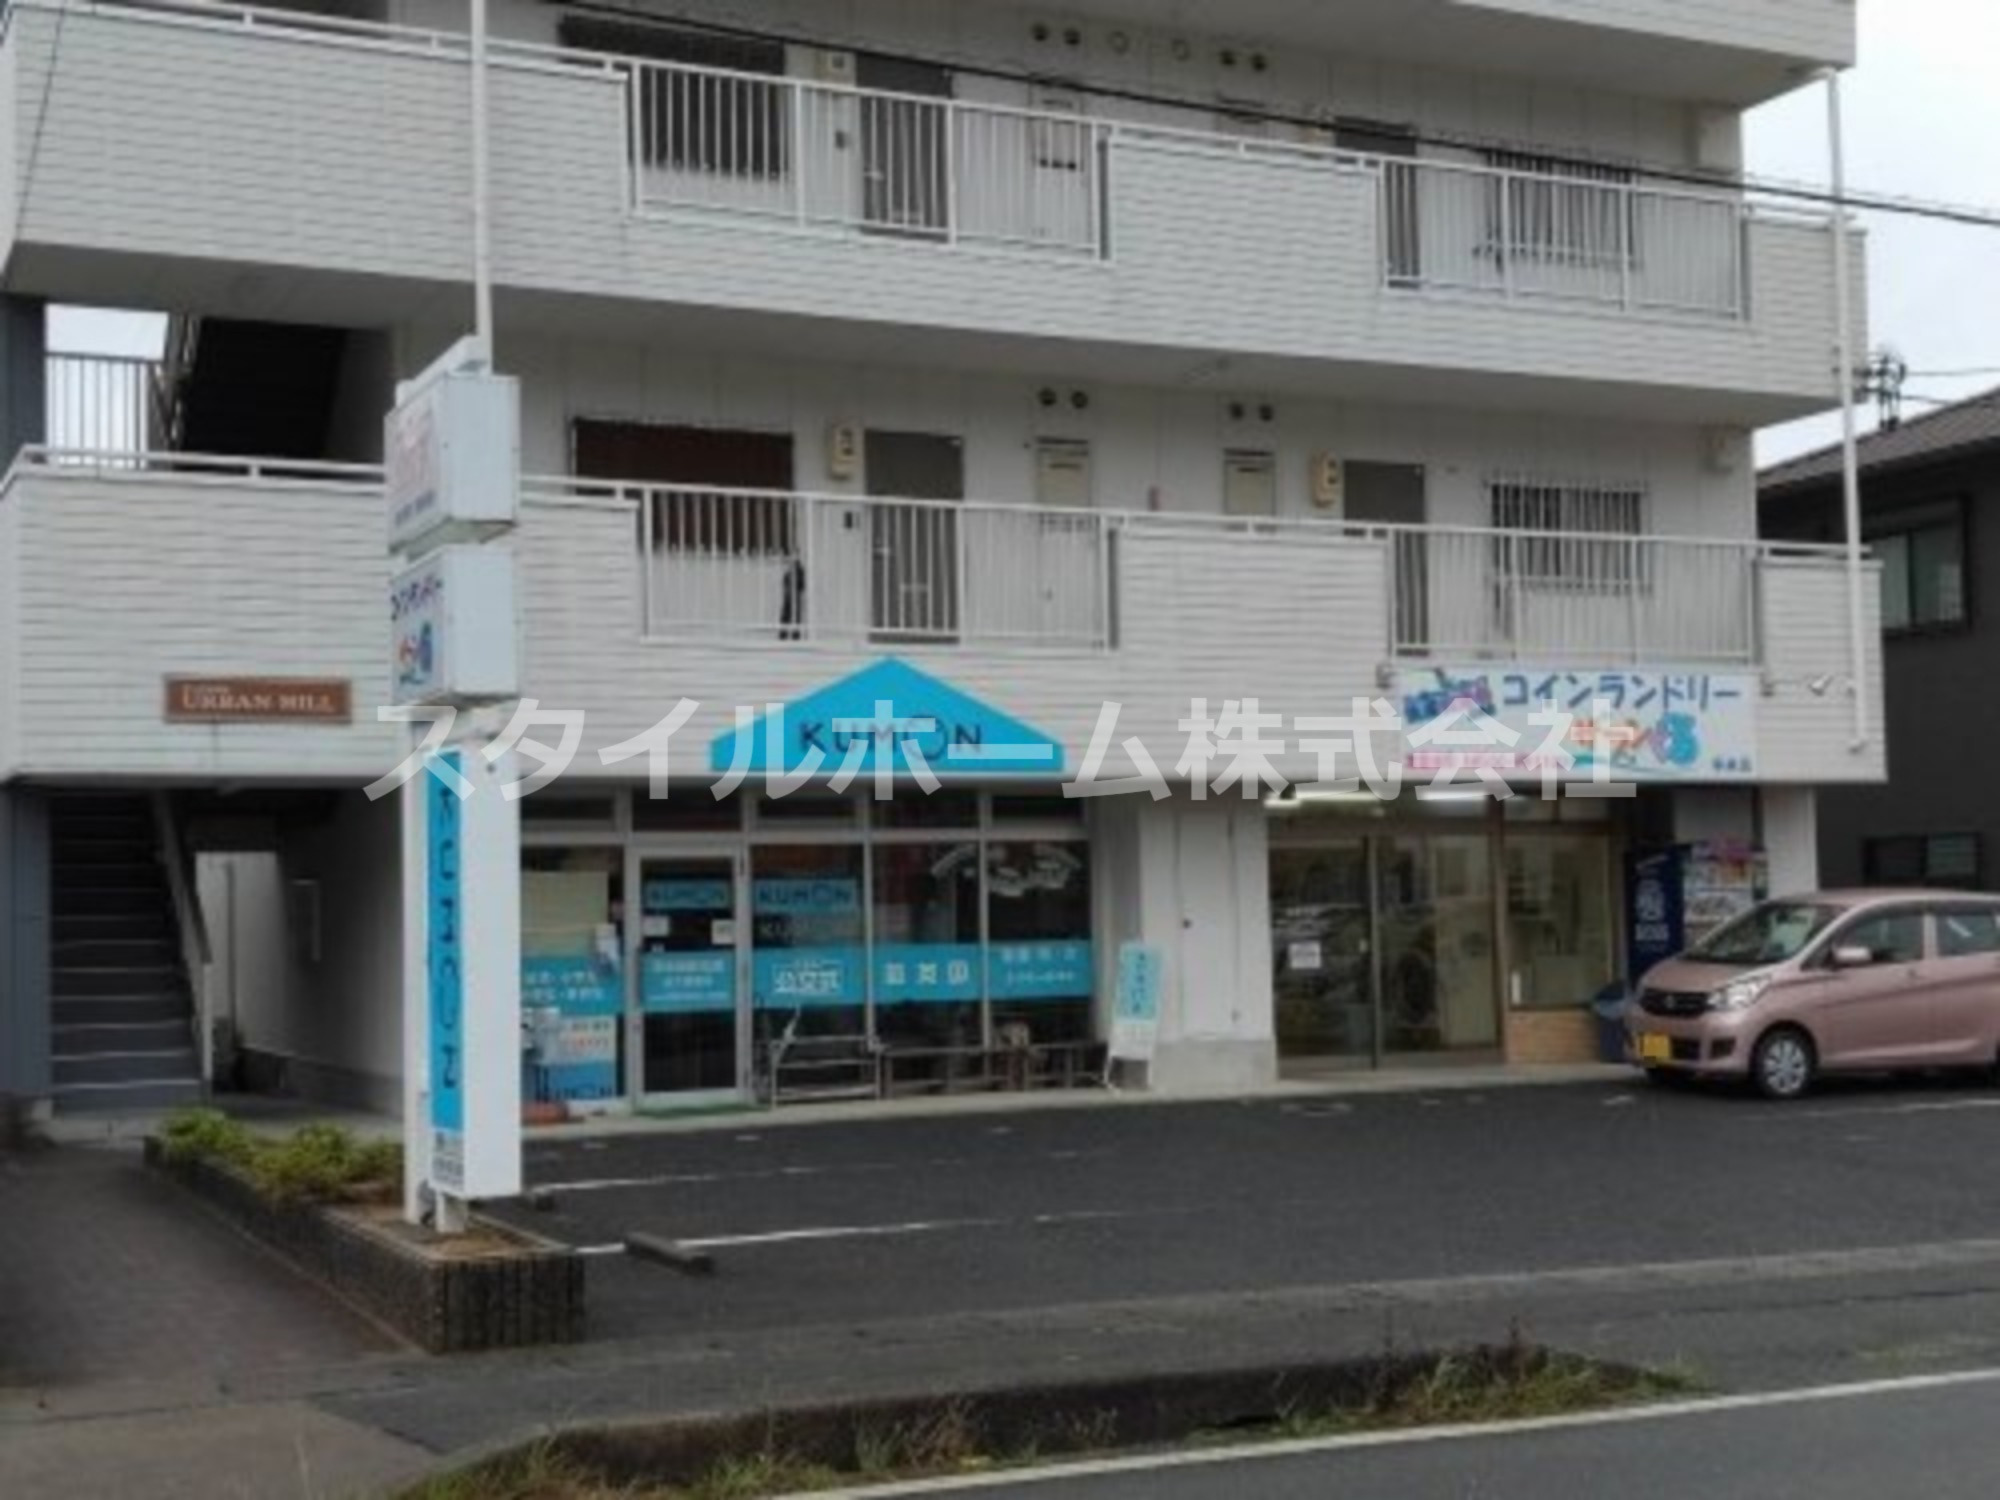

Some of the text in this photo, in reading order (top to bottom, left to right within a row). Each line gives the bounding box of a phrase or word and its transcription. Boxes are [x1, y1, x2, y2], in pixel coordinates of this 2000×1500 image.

[1503, 674, 1740, 710] コインランドリー
[799, 715, 982, 761] KUMON
